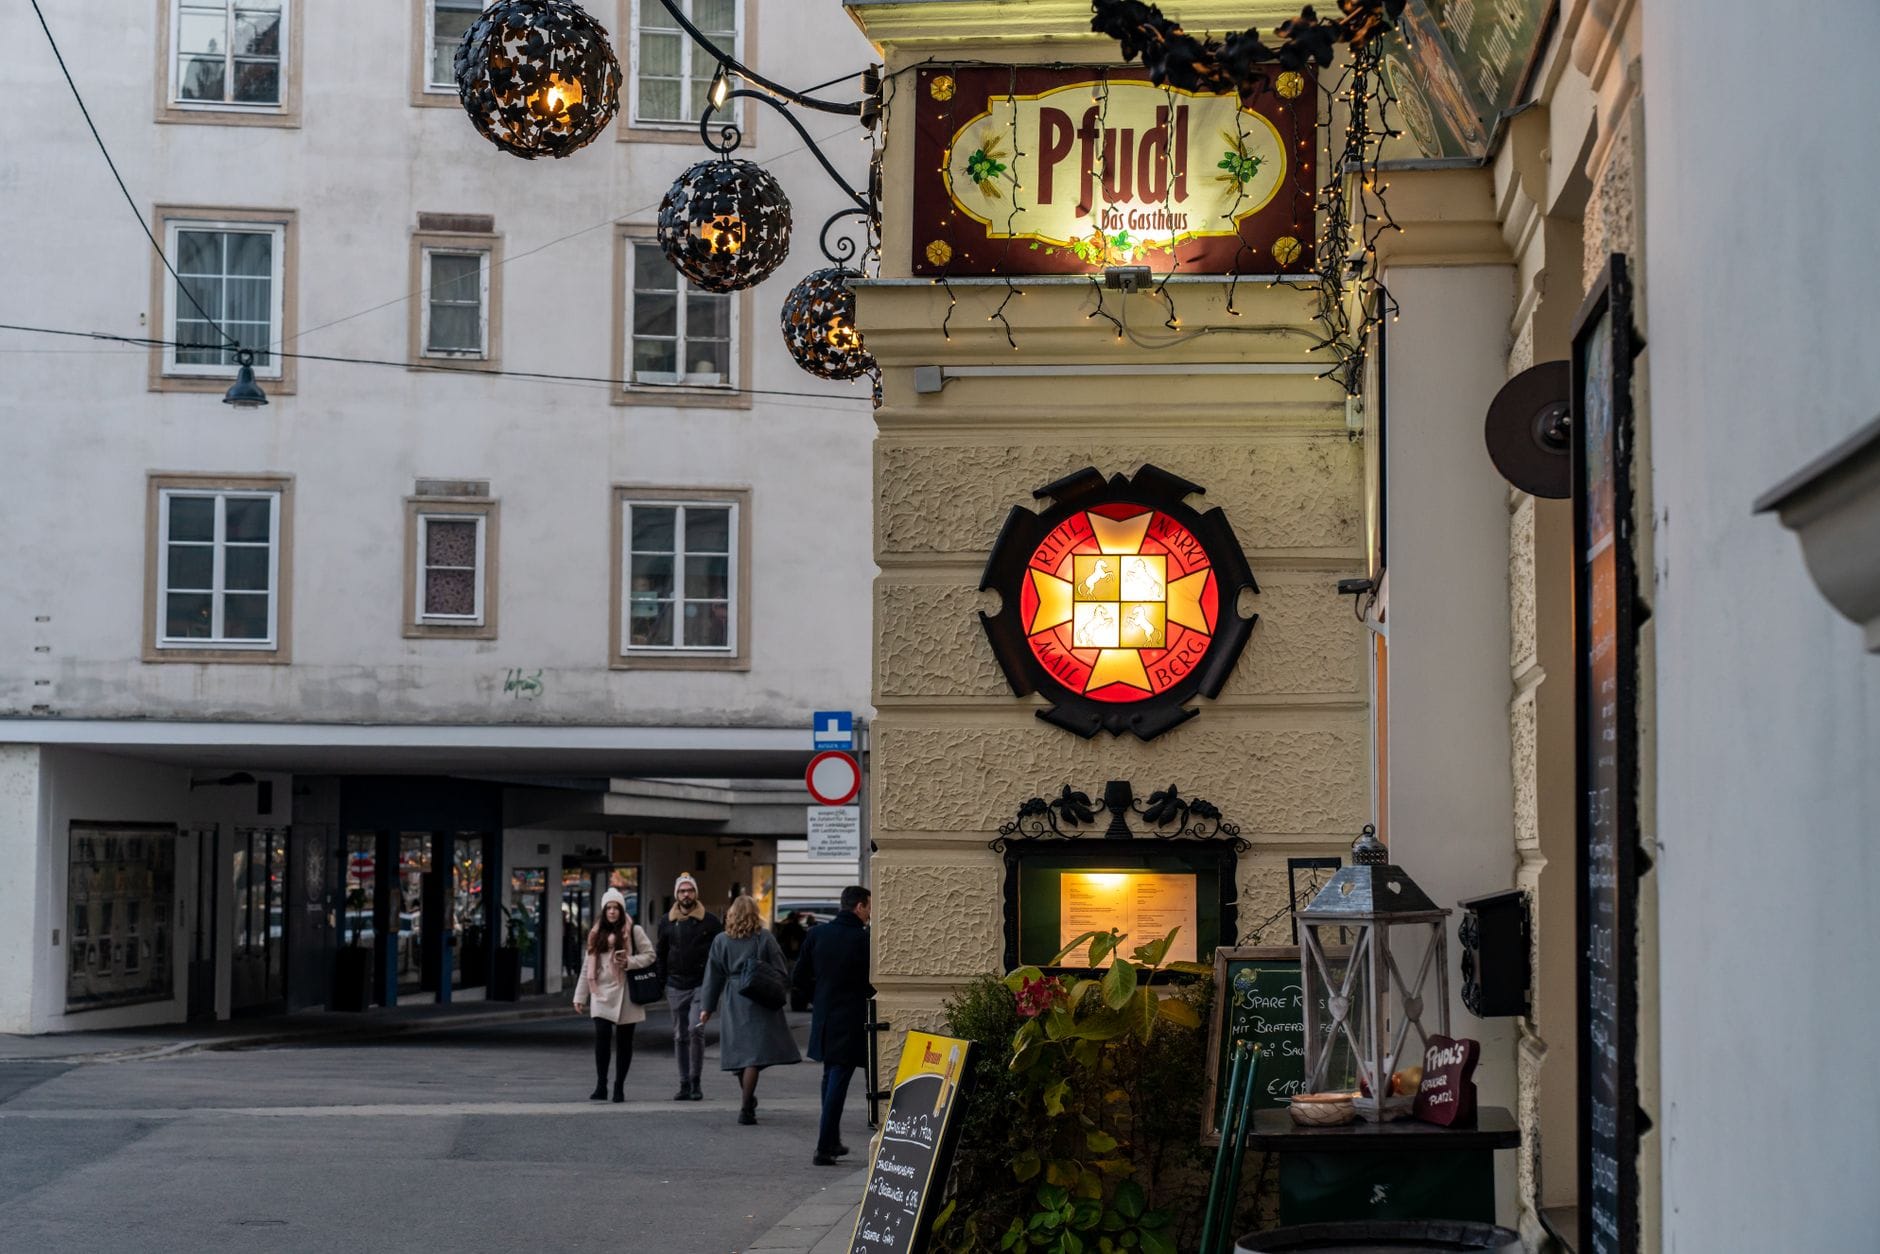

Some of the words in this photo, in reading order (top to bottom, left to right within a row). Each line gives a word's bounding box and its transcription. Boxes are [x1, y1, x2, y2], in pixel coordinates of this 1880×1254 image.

[1037, 104, 1189, 218] Pfudl
[1101, 211, 1124, 231] Das
[1128, 208, 1188, 231] Gasthaus
[1152, 517, 1208, 567] MARKT
[1155, 637, 1206, 688] BERG
[1242, 989, 1287, 1010] SPARE
